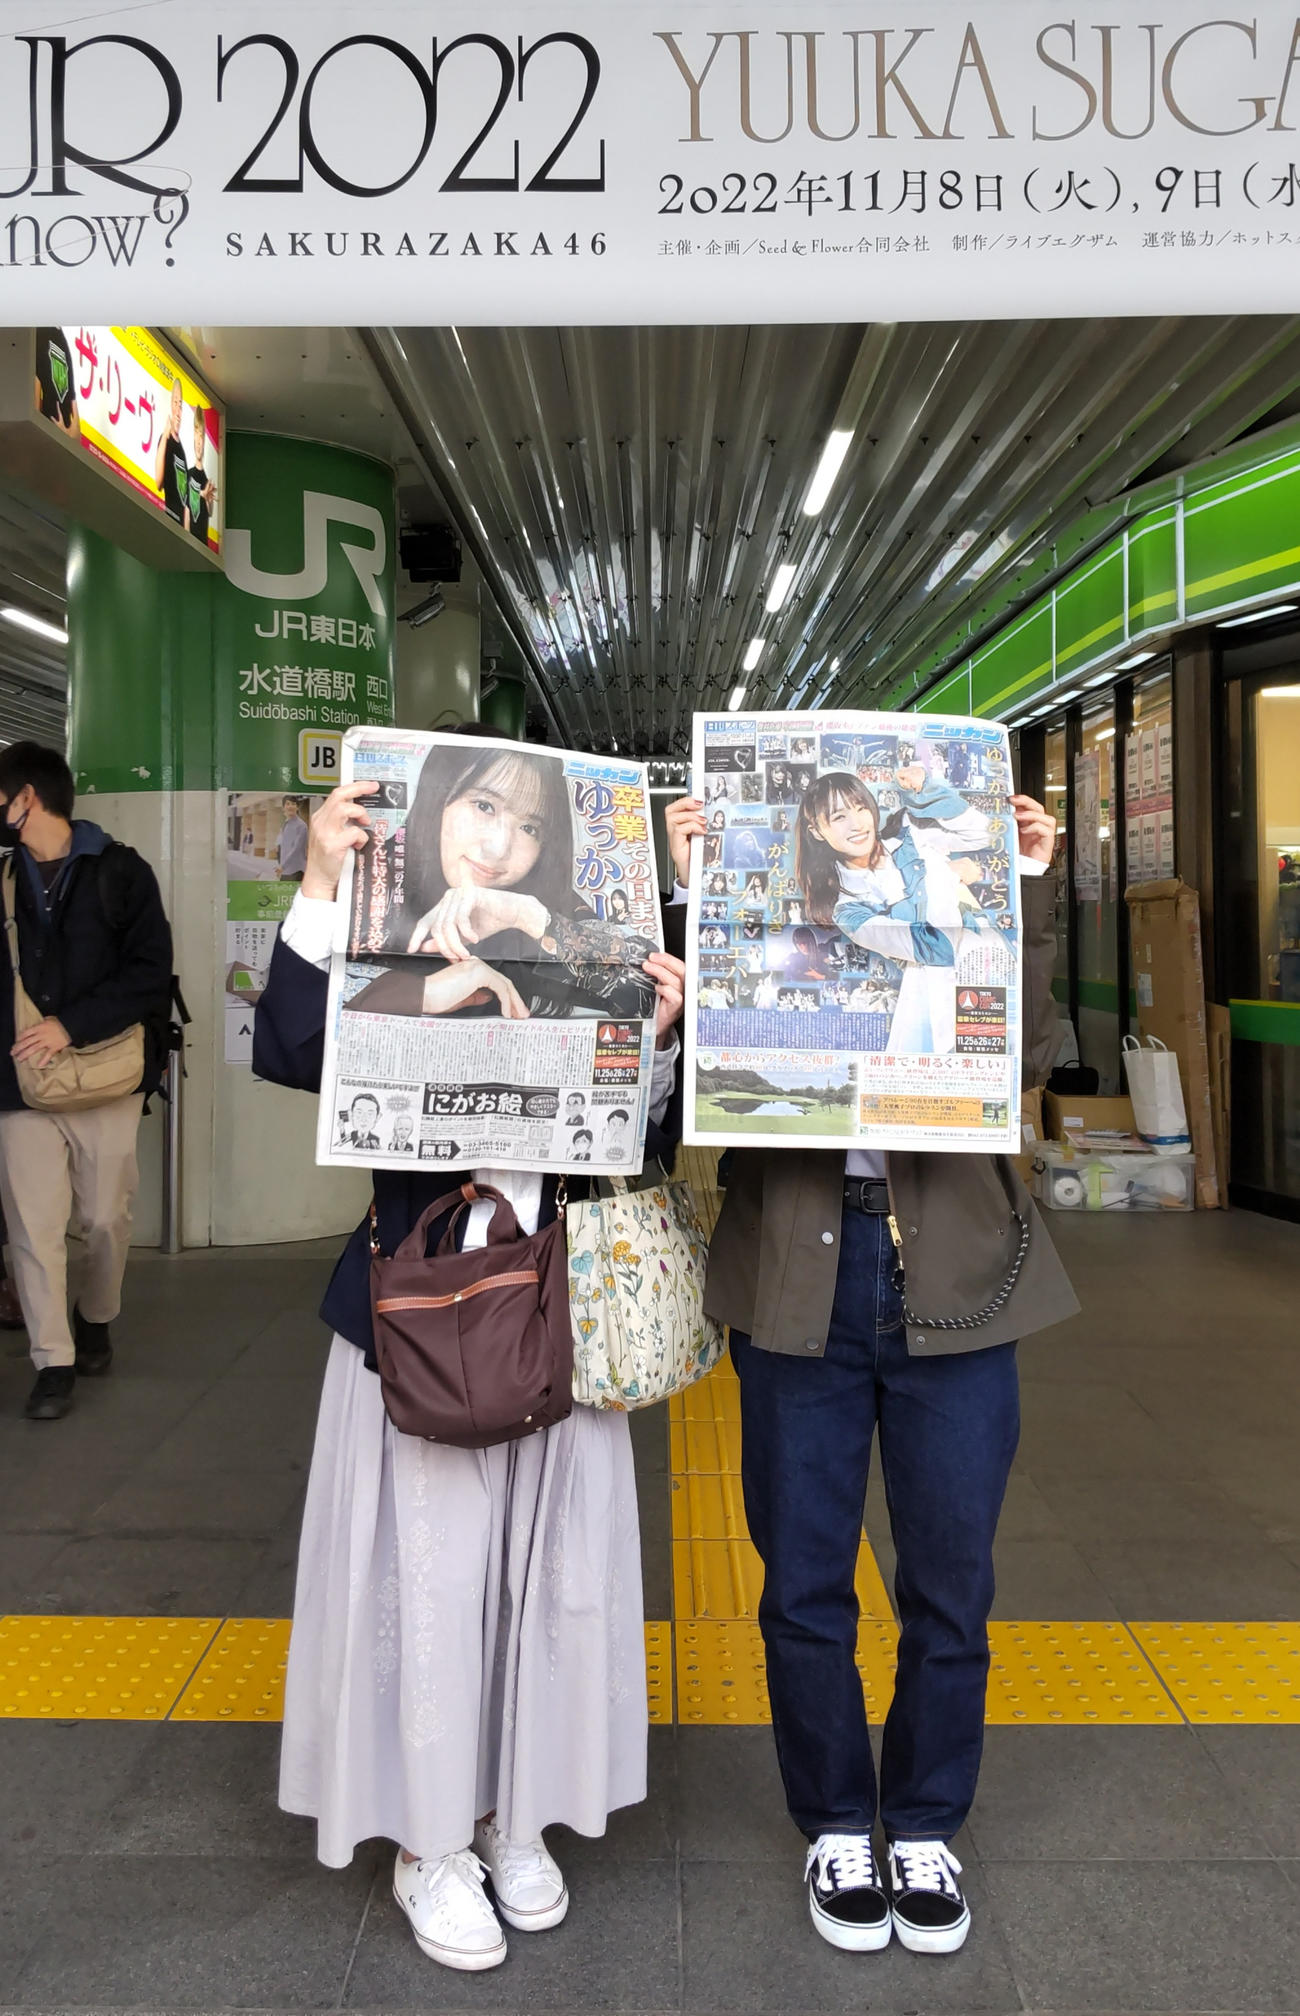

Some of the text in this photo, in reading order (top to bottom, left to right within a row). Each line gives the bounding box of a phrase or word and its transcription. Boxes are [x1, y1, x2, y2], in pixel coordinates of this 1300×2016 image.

[653, 21, 1015, 143] YUUKA
[216, 32, 605, 197] 2022
[0, 188, 190, 267] now?
[226, 232, 607, 257] SAKURAZAKA46
[1142, 230, 1300, 248] 運営協力／ホットス
[224, 489, 387, 617] JR
[254, 610, 376, 651] JR東日本
[239, 664, 388, 702] 水道橋駅 西口
[239, 701, 317, 722] Suidōbashi
[321, 706, 360, 725] Station
[923, 723, 1004, 744] ニッカン
[311, 746, 336, 769] JB
[567, 761, 642, 785] ニッカン
[574, 779, 623, 921] ゆっかー
[613, 785, 657, 940] 卒業その日まで
[428, 1092, 523, 1115] にがお絵
